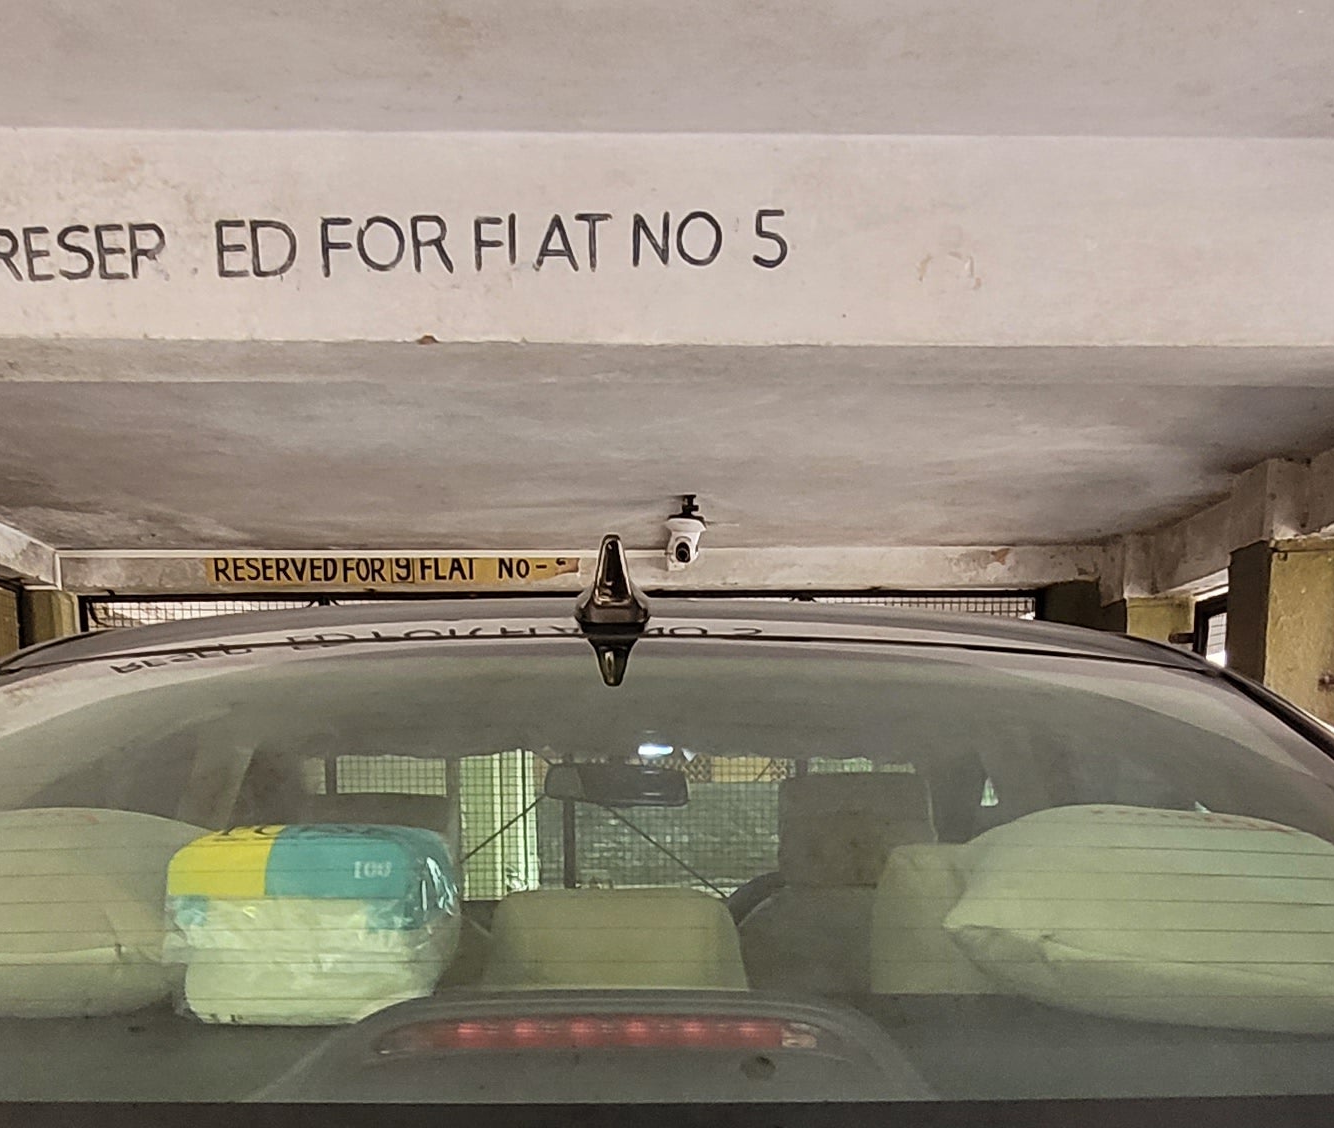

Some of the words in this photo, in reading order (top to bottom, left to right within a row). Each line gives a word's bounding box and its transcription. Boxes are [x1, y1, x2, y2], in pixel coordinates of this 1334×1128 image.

[320, 213, 454, 277] FOR
[632, 209, 722, 267] NO
[752, 208, 788, 268] 5
[213, 557, 338, 582] RESERVED
[342, 557, 387, 583] FOR
[419, 557, 475, 581] FLAT
